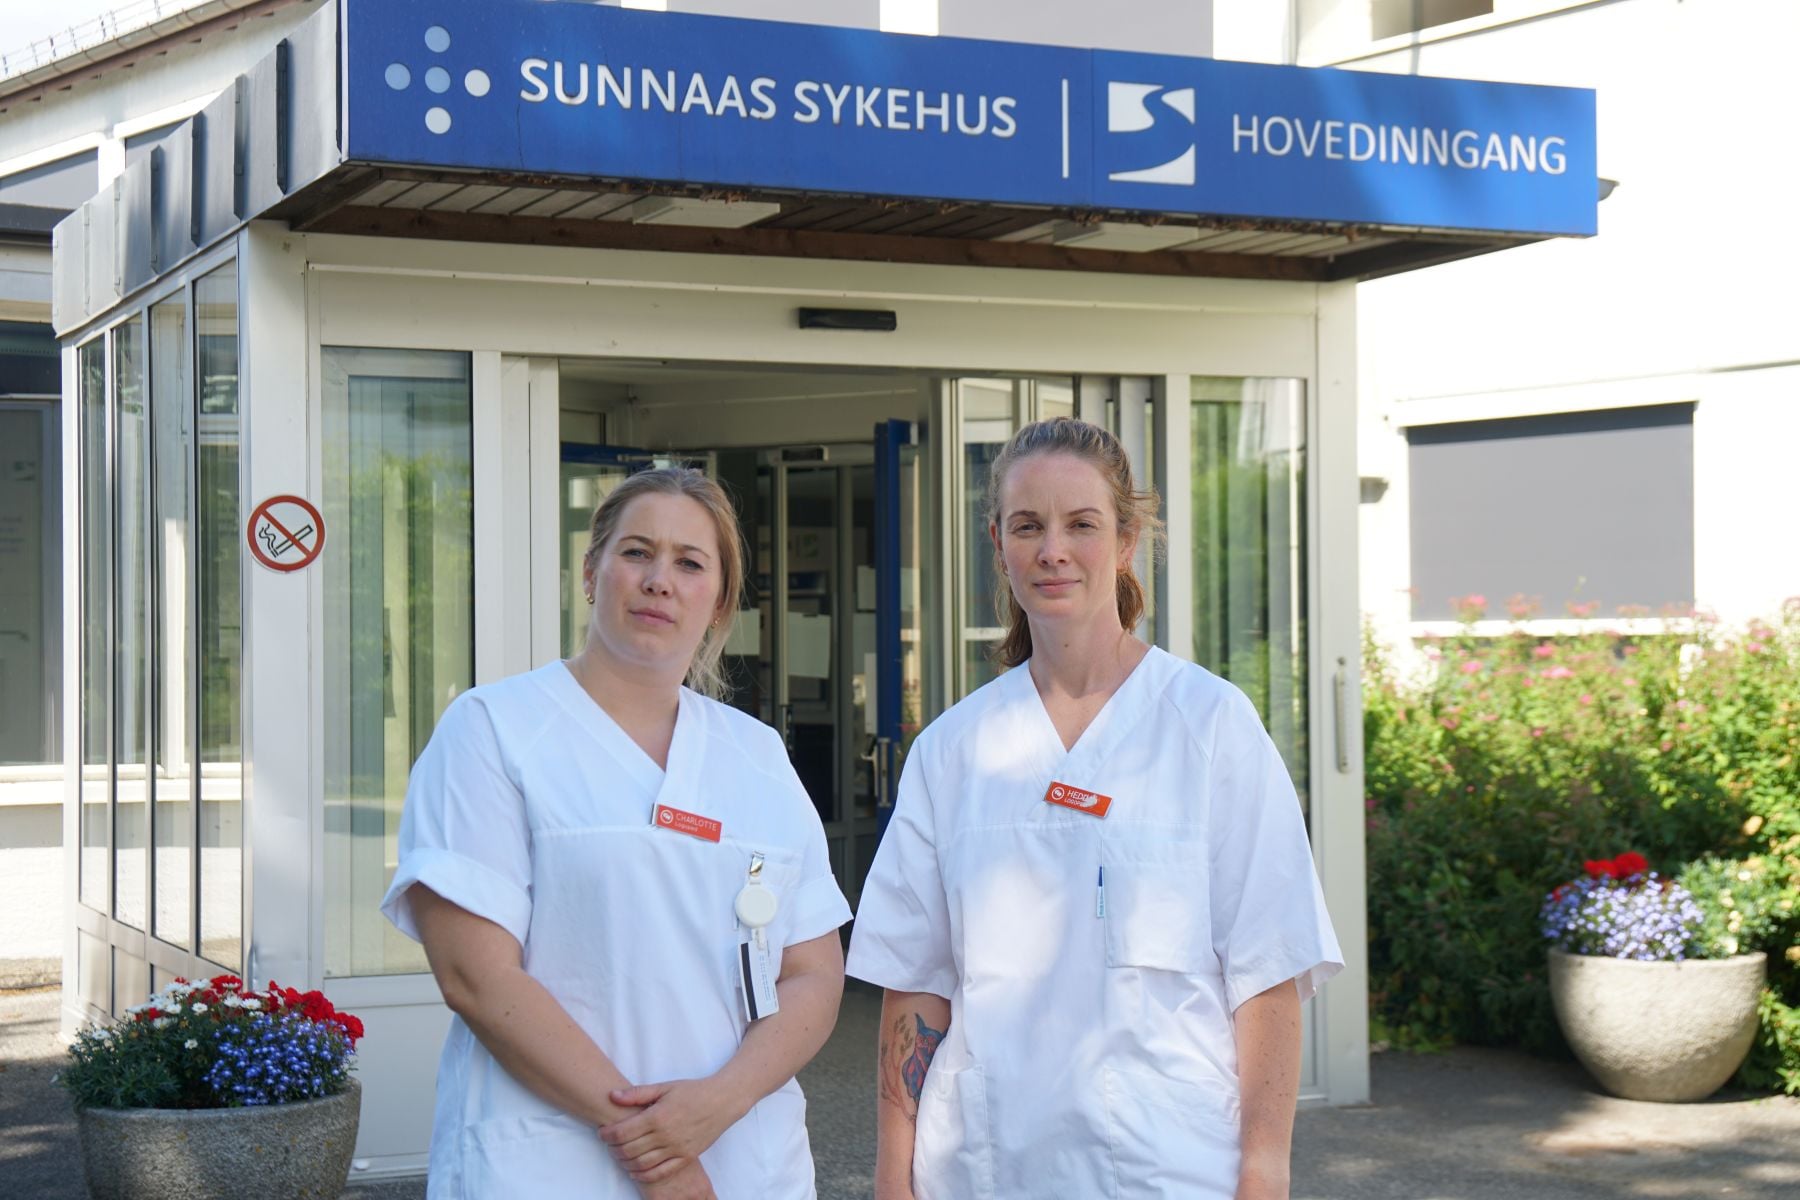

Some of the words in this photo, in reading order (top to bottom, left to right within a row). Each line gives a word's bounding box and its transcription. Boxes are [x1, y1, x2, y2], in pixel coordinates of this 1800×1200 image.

[520, 58, 777, 120] SUNNAAS
[793, 80, 1017, 138] SYKEHUS
[1233, 114, 1567, 175] HOVEDINNGANG
[1066, 789, 1097, 801] HEDD
[675, 813, 718, 832] CHARLOTTE
